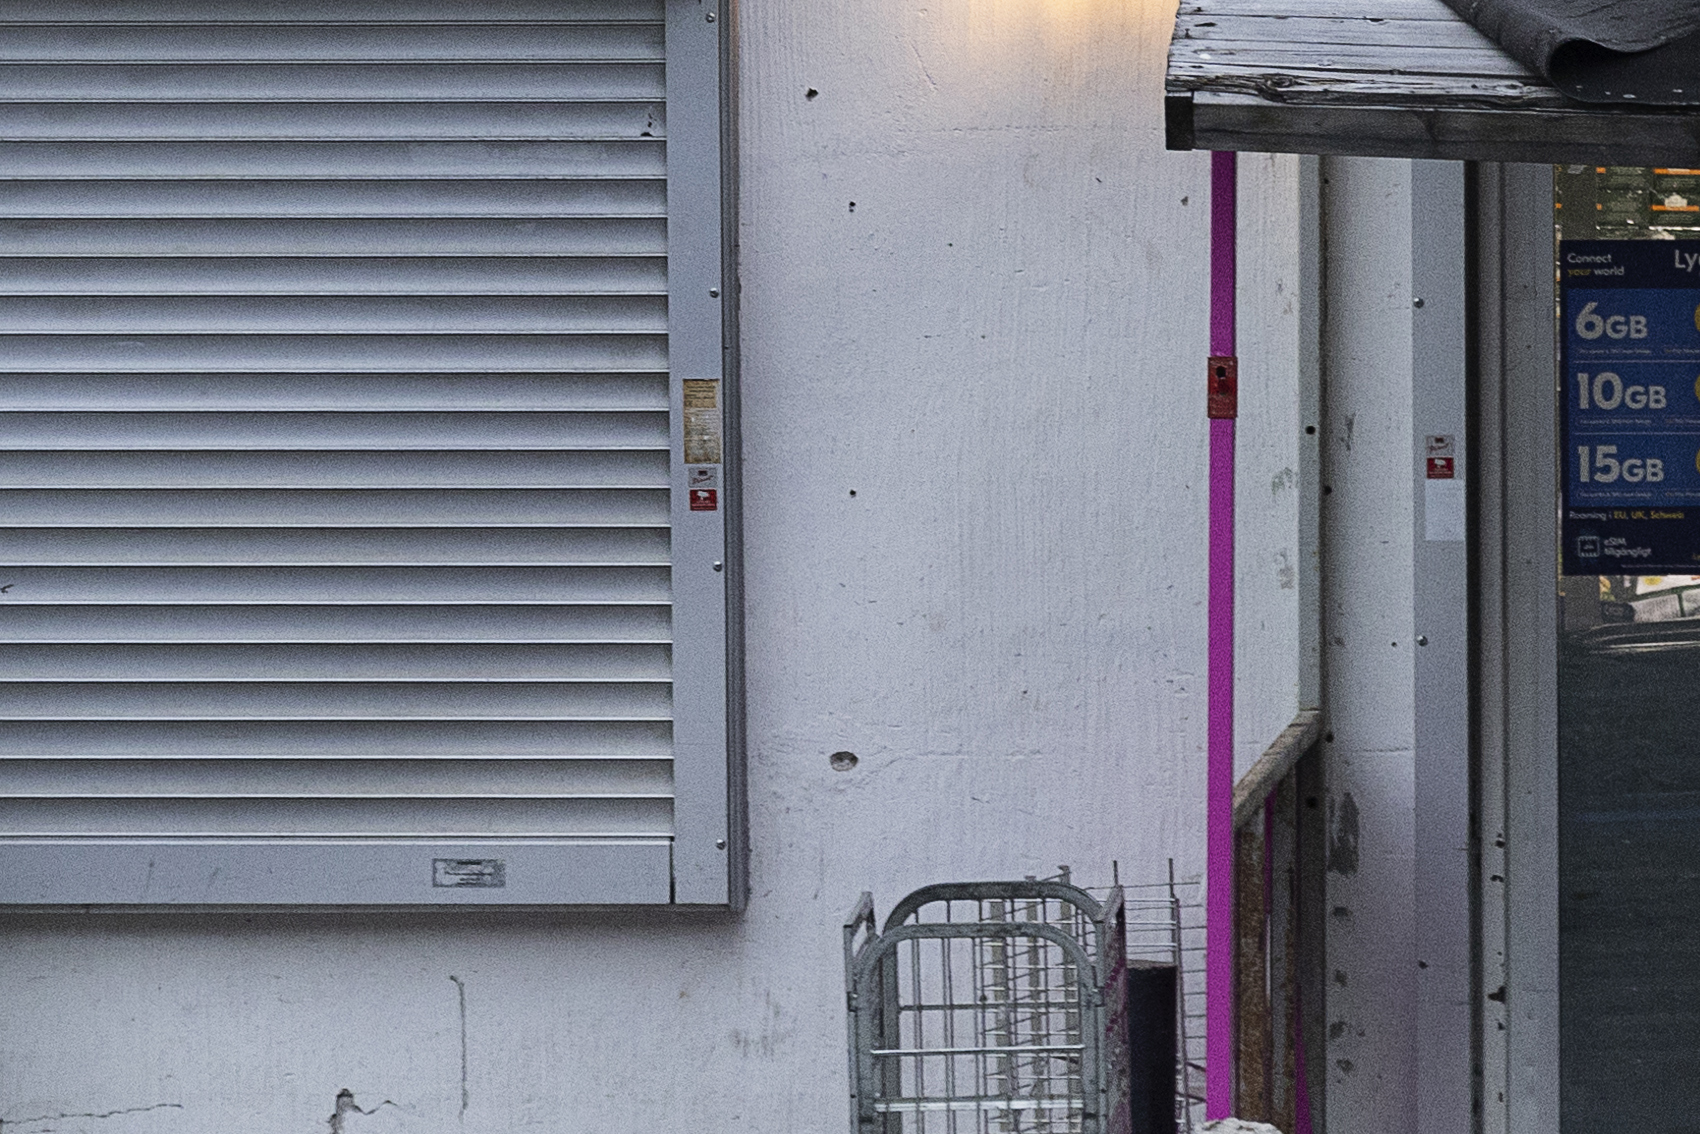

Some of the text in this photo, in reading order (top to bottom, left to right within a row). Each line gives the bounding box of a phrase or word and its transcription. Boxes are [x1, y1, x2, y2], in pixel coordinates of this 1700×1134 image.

[1566, 252, 1612, 264] Connect
[1567, 265, 1625, 277] your world
[1575, 302, 1648, 340] 6GB
[1577, 371, 1667, 410] 10GB
[1577, 445, 1666, 483] 15GB
[1569, 510, 1607, 521] Roaming
